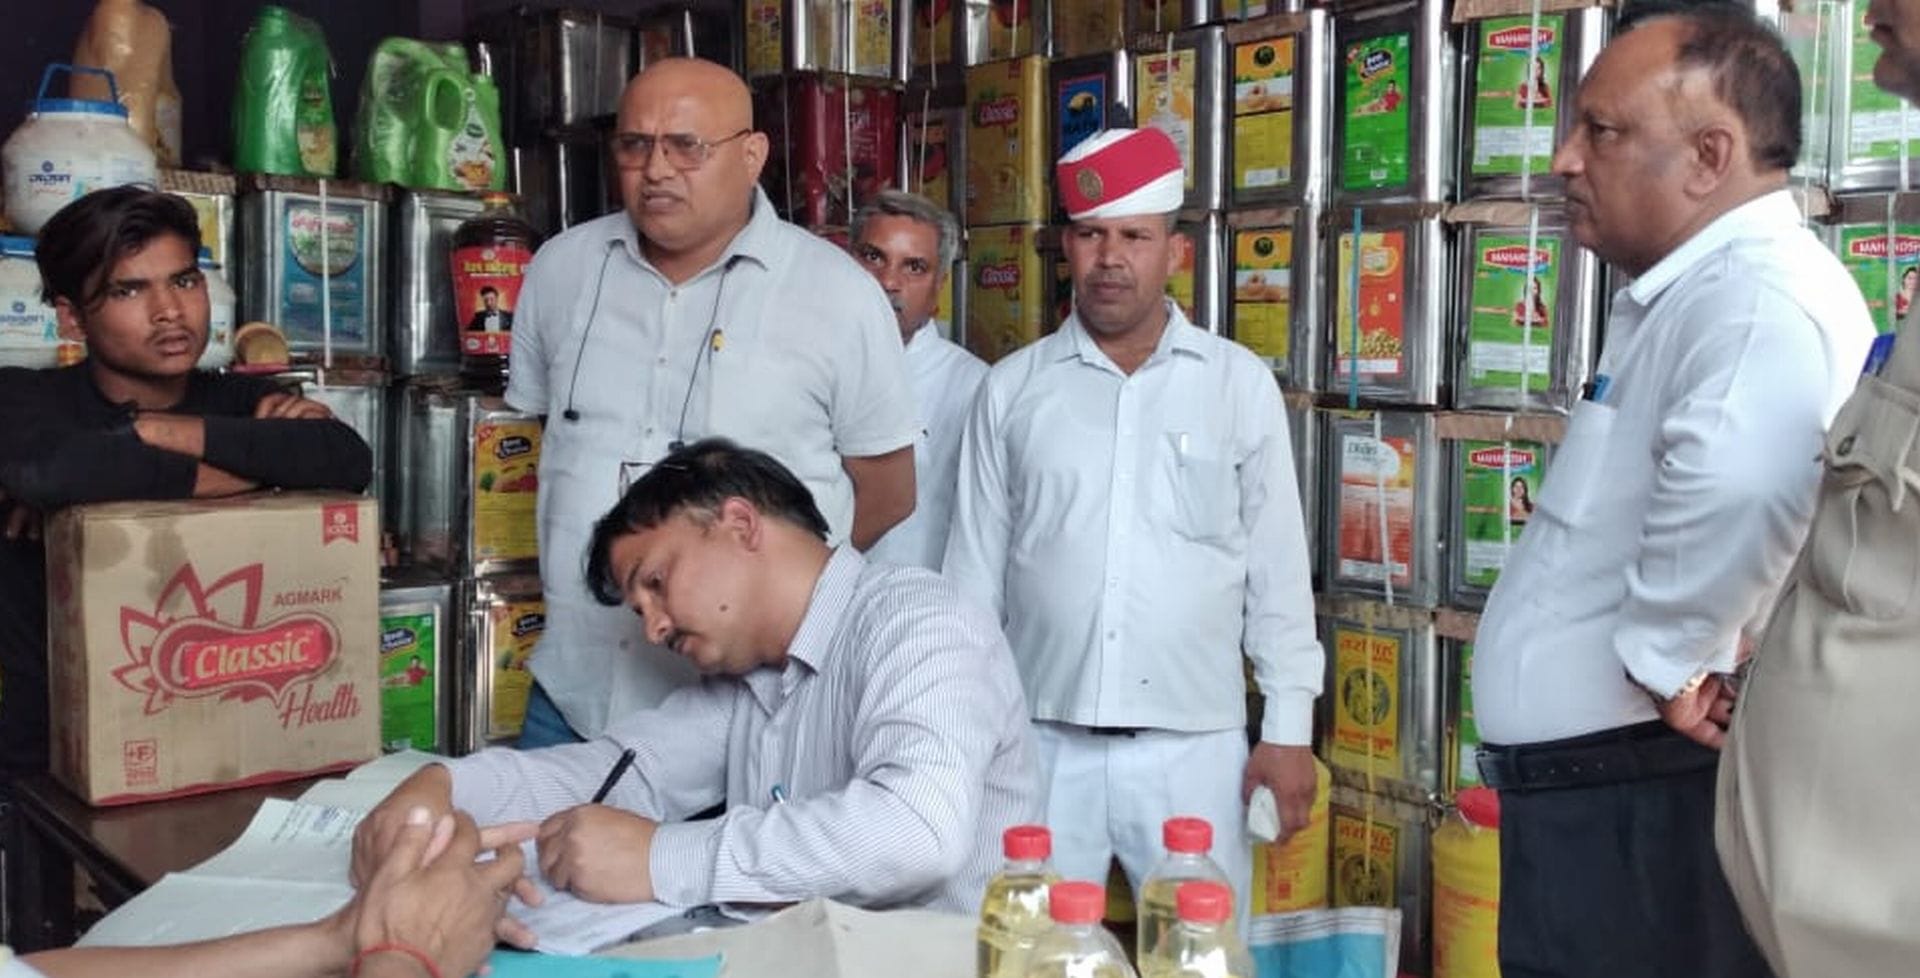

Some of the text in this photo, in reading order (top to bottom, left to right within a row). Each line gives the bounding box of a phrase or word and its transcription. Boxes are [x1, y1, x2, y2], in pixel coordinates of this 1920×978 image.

[274, 586, 343, 607] AGMARK
[194, 630, 312, 680] Classic
[280, 682, 362, 731] Health
